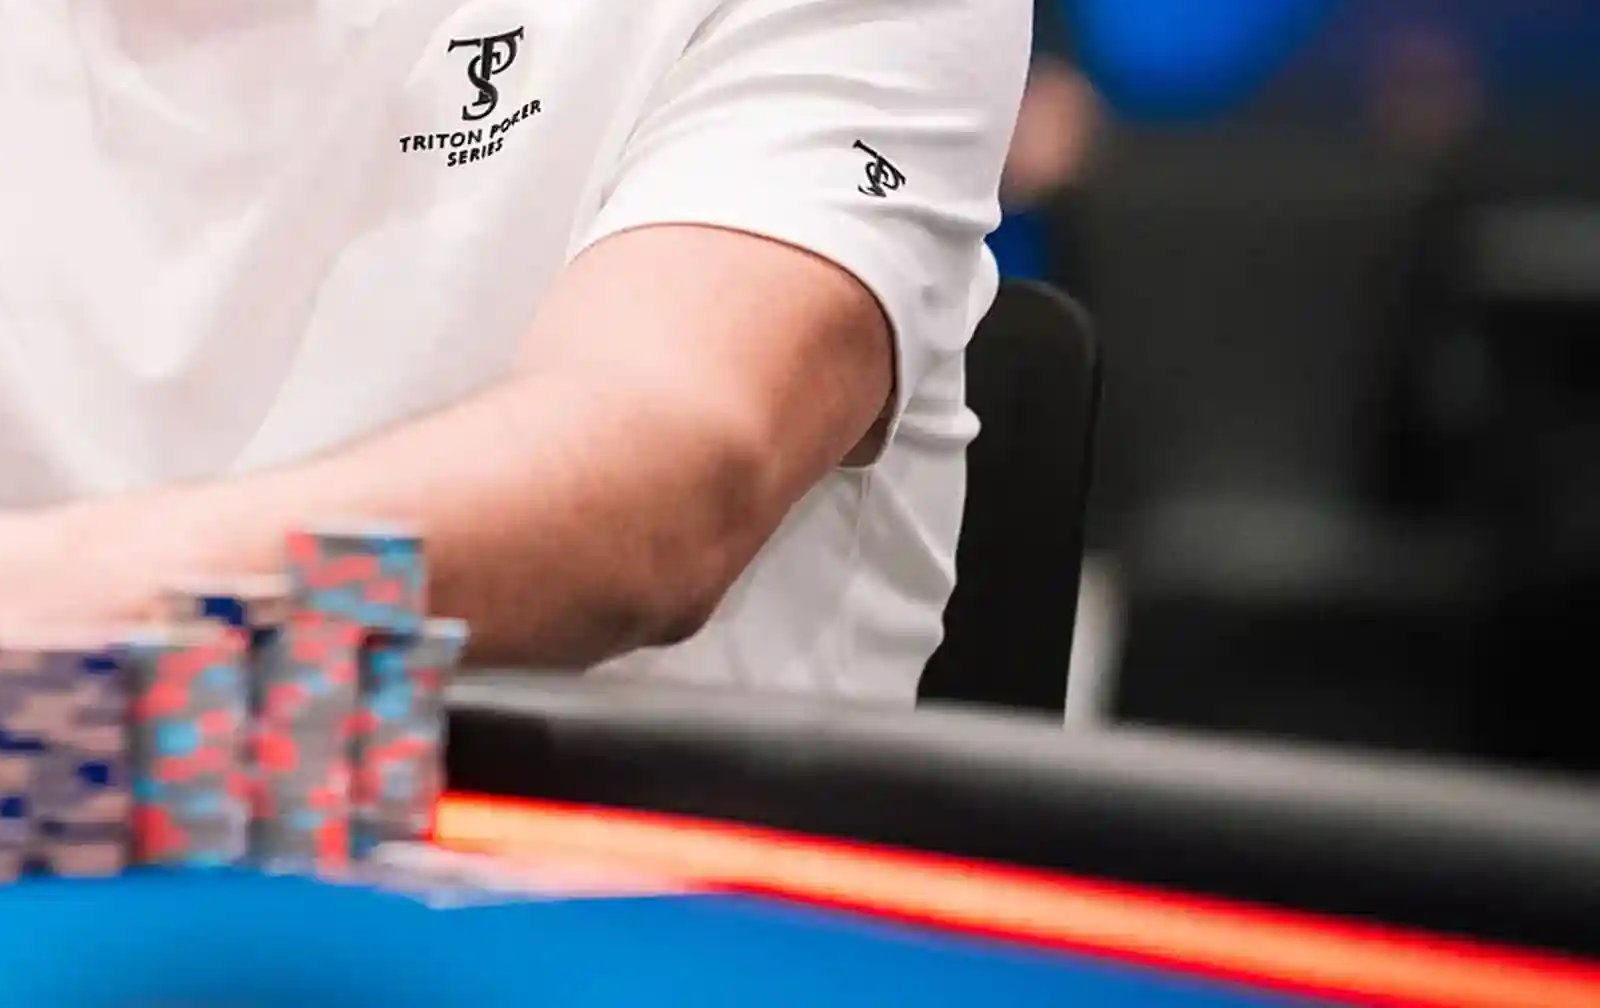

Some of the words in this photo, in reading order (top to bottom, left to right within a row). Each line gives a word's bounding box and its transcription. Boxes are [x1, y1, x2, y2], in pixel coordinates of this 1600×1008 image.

[399, 128, 483, 153] TRITON
[489, 99, 541, 139] POKER
[447, 137, 503, 167] SERIES
